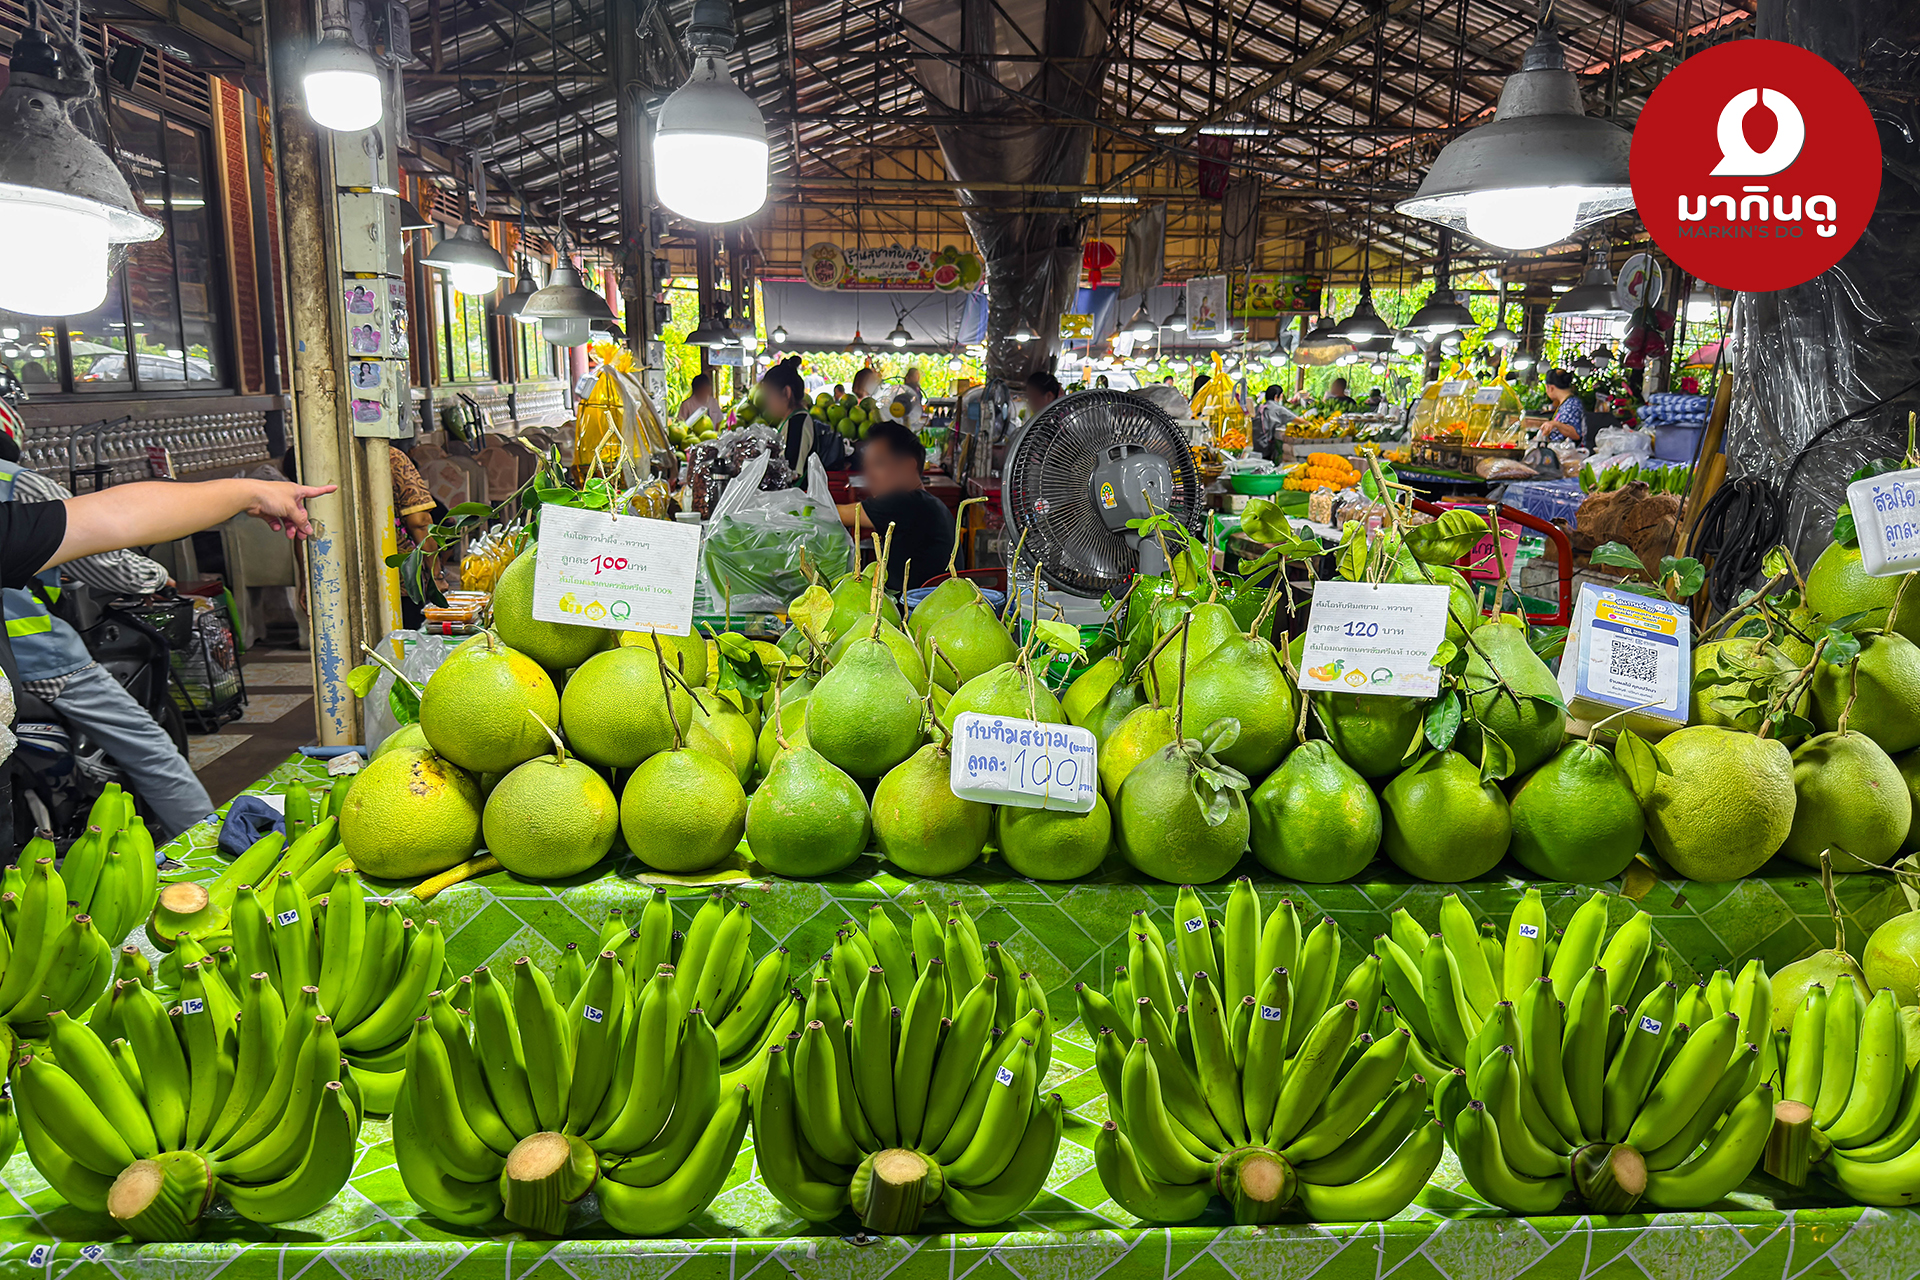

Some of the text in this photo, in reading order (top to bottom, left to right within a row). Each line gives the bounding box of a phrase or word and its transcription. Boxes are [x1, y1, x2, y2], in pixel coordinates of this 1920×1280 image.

[1885, 522, 1919, 547] ลูกละ
[561, 555, 647, 575] ลูกละ 100 บาท
[653, 587, 673, 595] 100%
[1316, 600, 1379, 610] ส้มโอทับทิมสยาม
[1313, 621, 1404, 637] ลูกละ 120 บาท
[966, 719, 1068, 748] ทับทิมสยาม
[968, 755, 1007, 777] ลูกละ
[1014, 749, 1078, 788] 100
[278, 911, 297, 925] 150
[1520, 926, 1536, 936] 140
[186, 1000, 203, 1014] 150
[585, 1005, 603, 1020] 150
[1261, 1005, 1280, 1019] 120
[1640, 1016, 1660, 1031] 130
[995, 1066, 1012, 1081] 130
